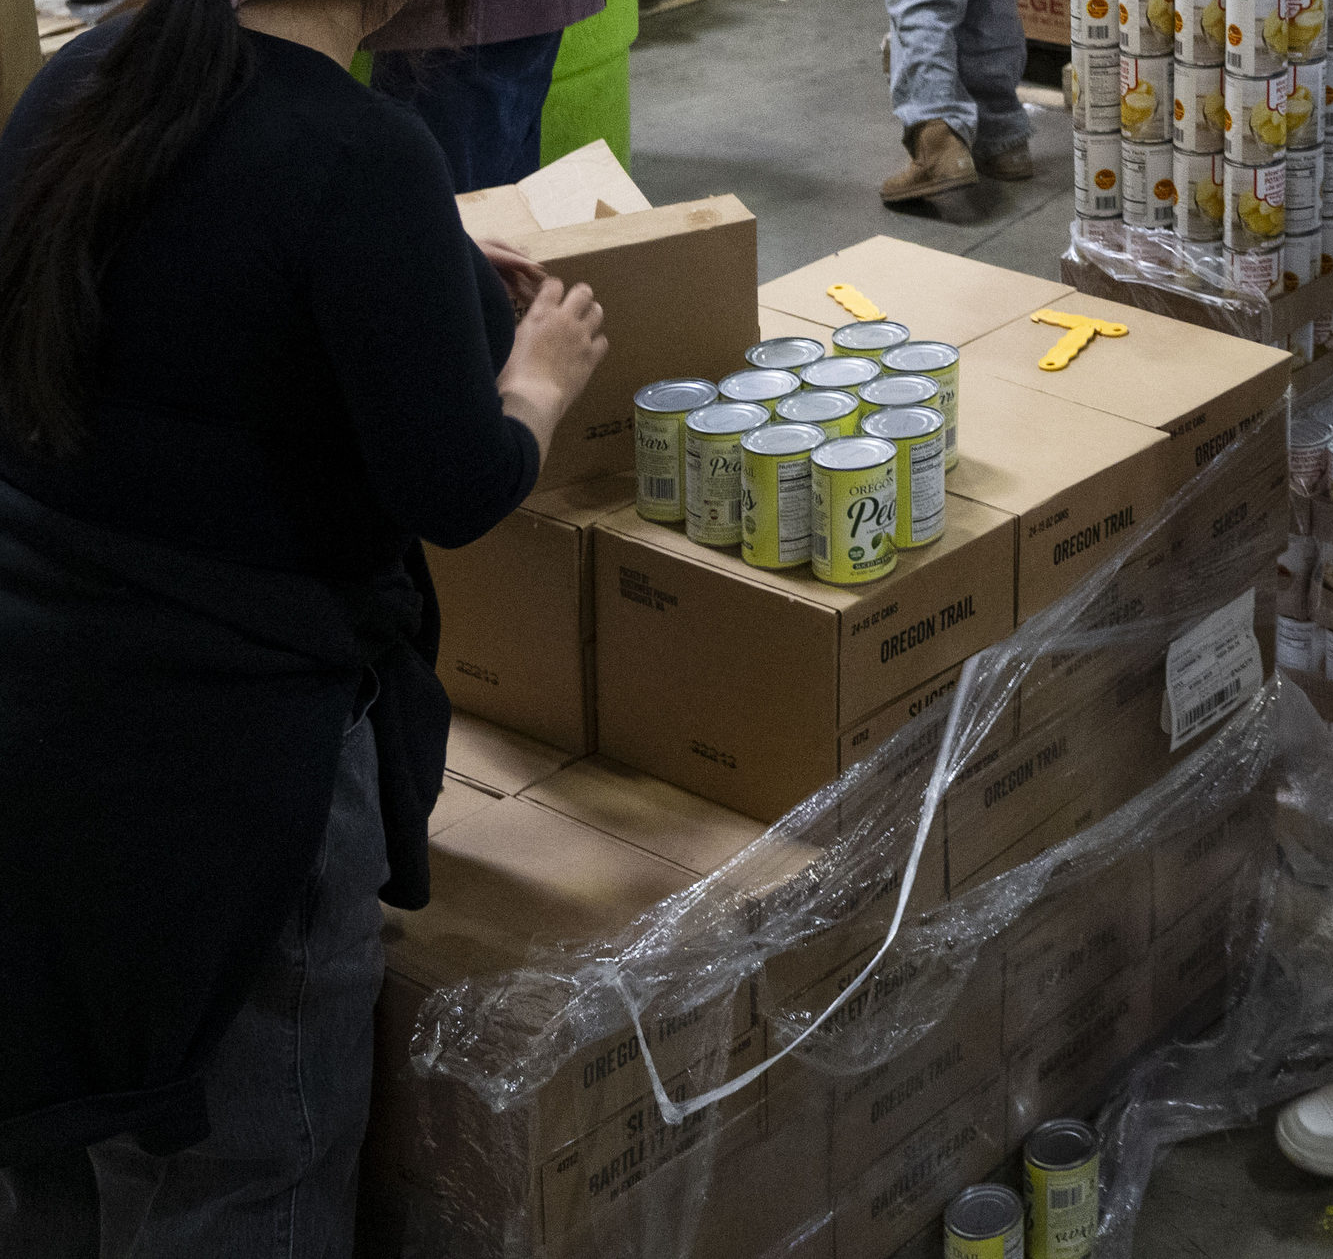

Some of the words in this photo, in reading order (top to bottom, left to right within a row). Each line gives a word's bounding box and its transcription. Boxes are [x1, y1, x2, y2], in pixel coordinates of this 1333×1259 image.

[1054, 522, 1101, 566] OREGON
[1104, 505, 1136, 539] TRAIL
[851, 618, 870, 636] 24-15
[871, 611, 880, 626] OZ
[881, 602, 899, 620] CANS
[881, 614, 936, 664] OREGON
[939, 595, 976, 631] TRAIL
